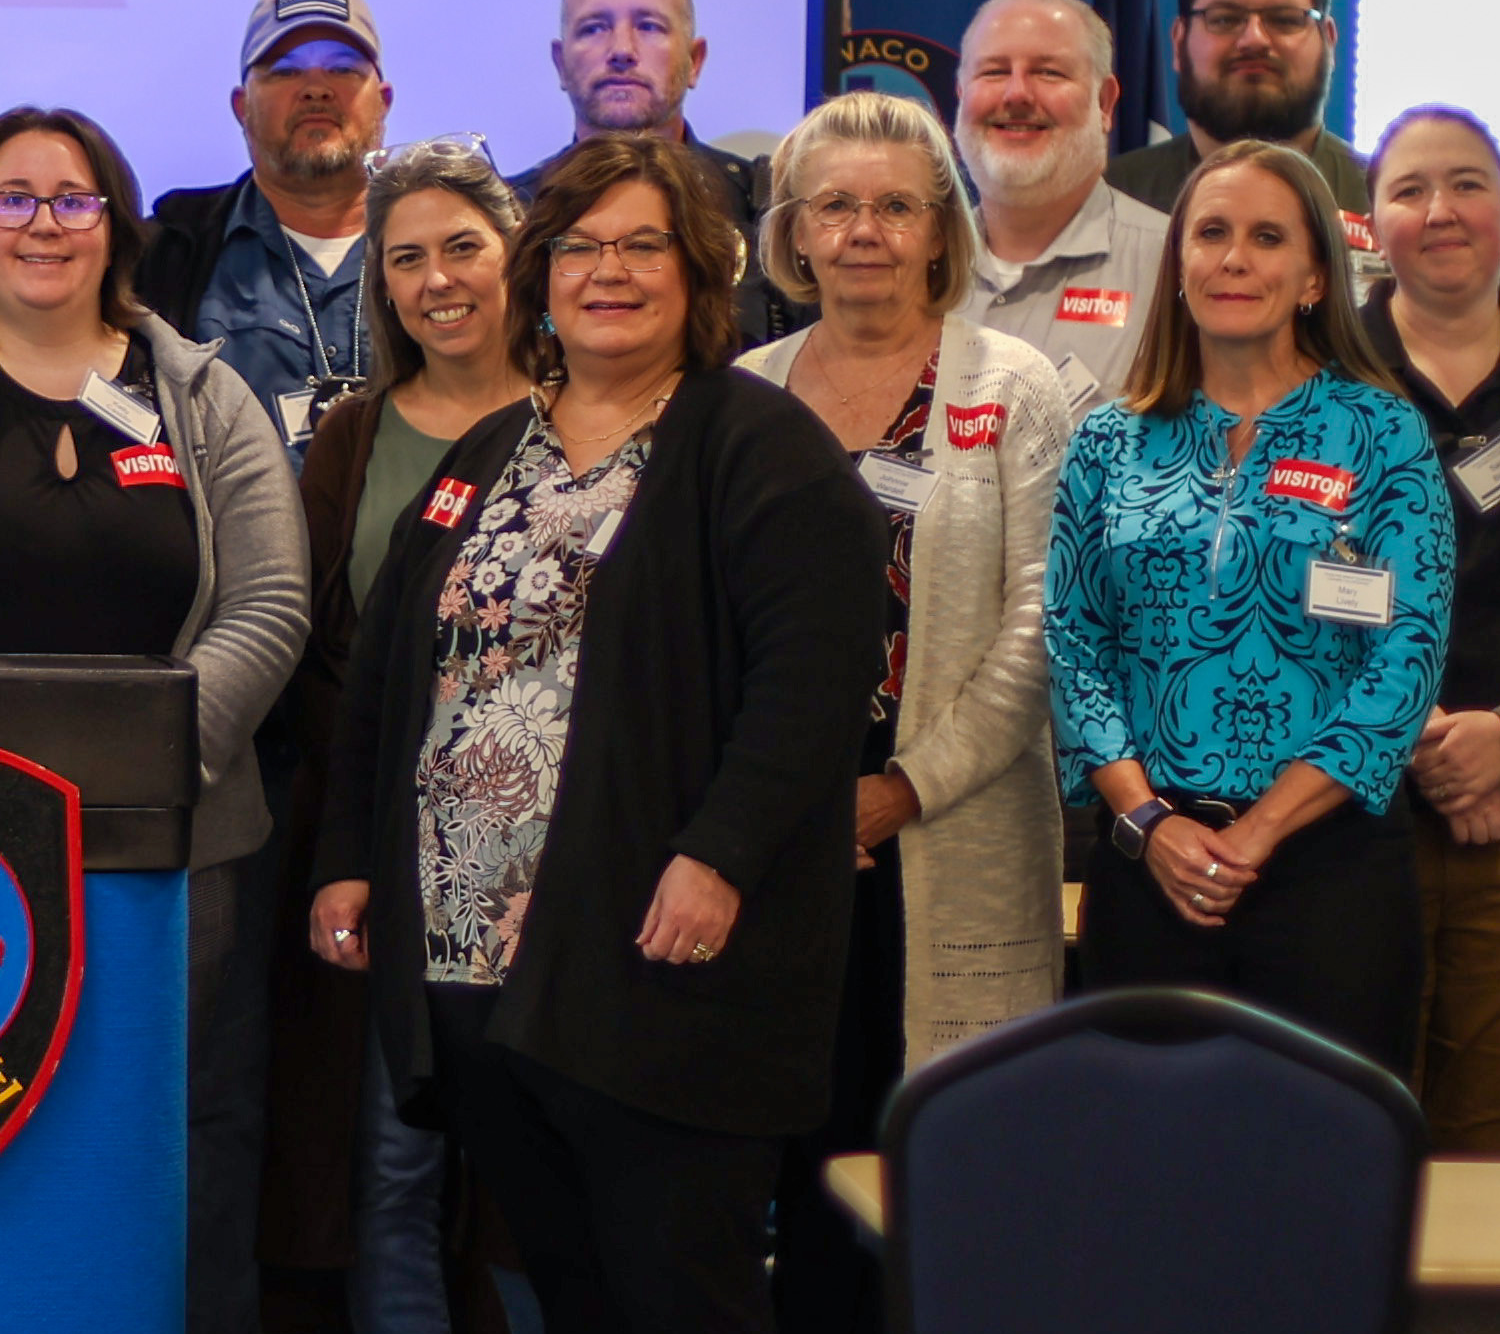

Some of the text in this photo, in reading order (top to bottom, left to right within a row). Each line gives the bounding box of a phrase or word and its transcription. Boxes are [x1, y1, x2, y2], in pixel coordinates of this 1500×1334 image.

[1062, 296, 1127, 318] VISITOR
[949, 413, 1002, 438] VISITO
[1272, 468, 1347, 500] VISITOR
